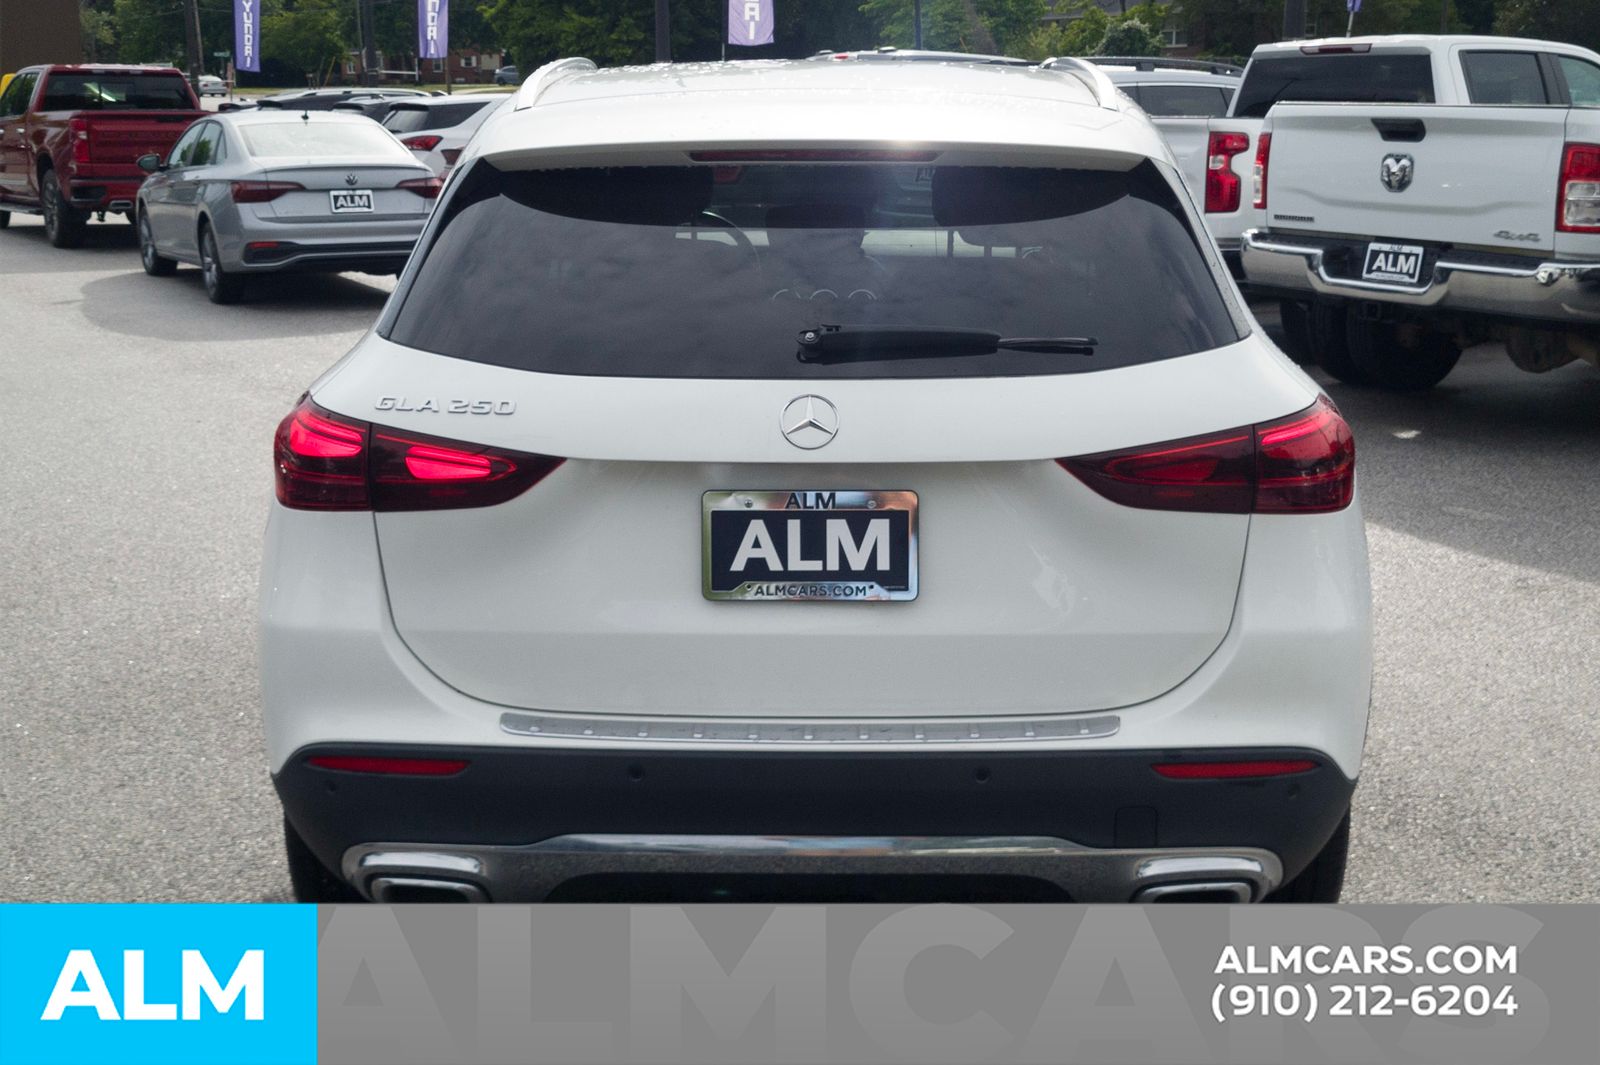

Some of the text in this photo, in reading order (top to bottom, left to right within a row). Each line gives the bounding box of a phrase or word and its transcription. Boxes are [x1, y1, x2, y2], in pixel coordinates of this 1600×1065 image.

[744, 0, 760, 40] AI
[336, 195, 369, 207] ALM
[1371, 252, 1417, 275] ALM
[375, 395, 518, 415] GLA 250
[785, 492, 836, 509] ALM
[729, 518, 891, 571] ALM
[754, 584, 867, 597] ALMCARS.COM
